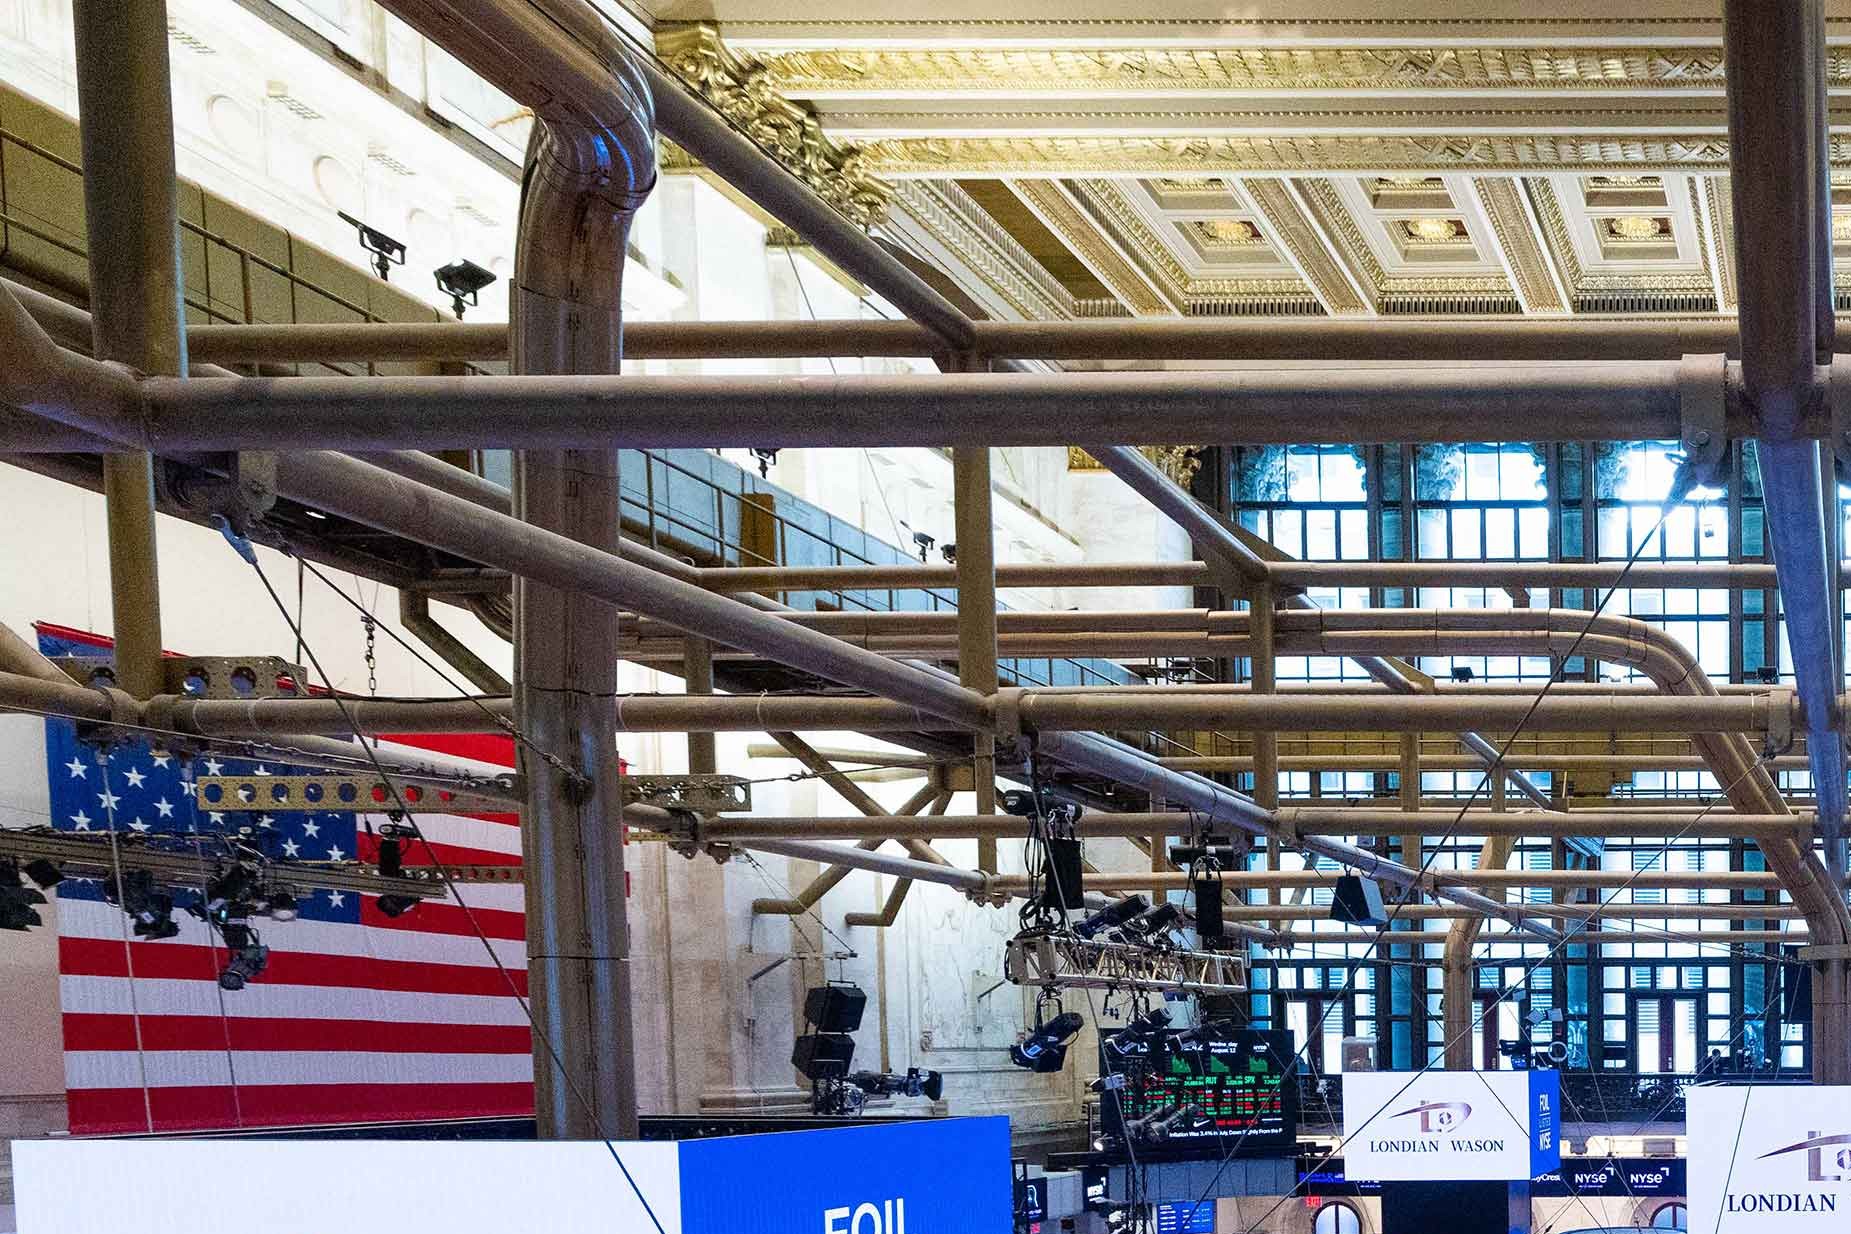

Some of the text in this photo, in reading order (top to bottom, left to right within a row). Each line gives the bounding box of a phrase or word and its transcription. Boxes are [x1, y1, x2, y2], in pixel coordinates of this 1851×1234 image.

[1370, 1139, 1504, 1153] LONDIAN WASON
[1728, 1193, 1836, 1212] LONDIAN
